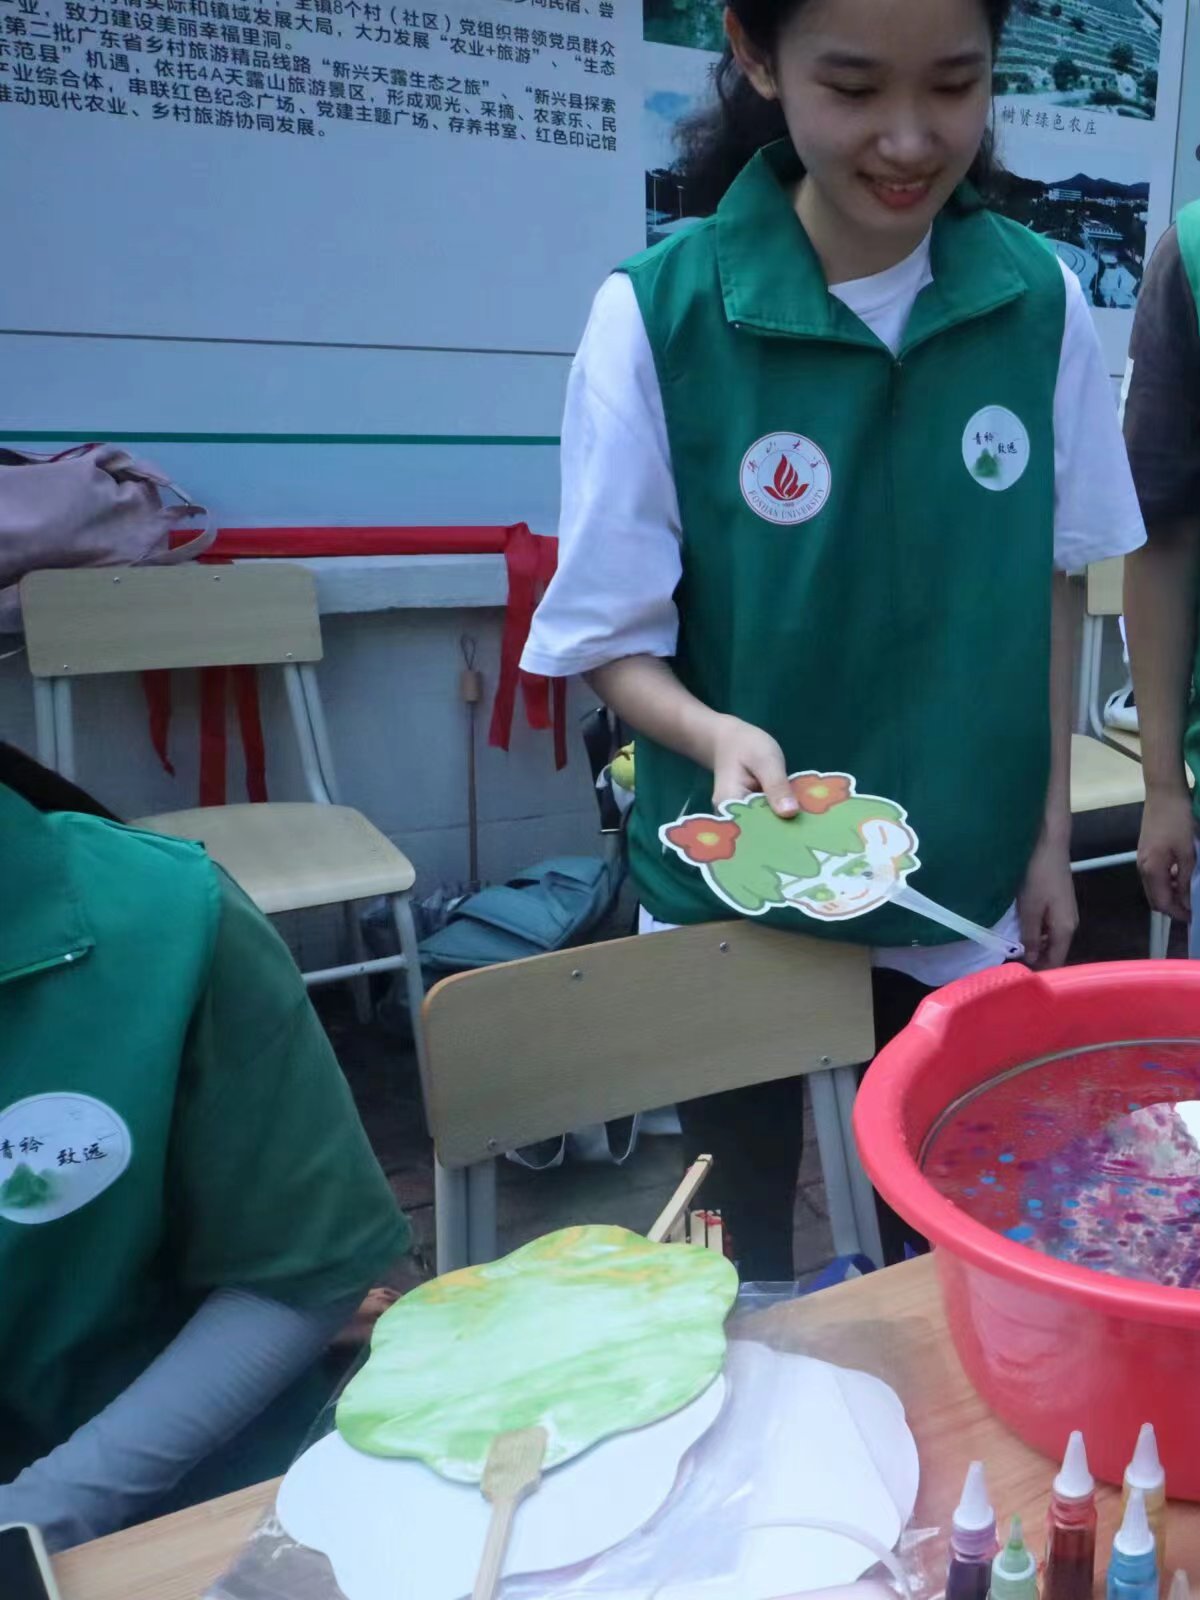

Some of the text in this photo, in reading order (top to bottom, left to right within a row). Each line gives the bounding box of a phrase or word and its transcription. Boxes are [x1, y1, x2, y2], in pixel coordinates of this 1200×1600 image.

[0, 0, 294, 51] 业，致力建设美丽幸福里洞。
[240, 0, 615, 57] ，全镇8个村（社区）党组织带领党员群众
[0, 16, 616, 114] 第二批广东省乡村旅游精品线路“新兴天露生态之旅”、“新兴县探索
[1002, 105, 1097, 135] 树贤绿色农庄
[748, 489, 778, 517] FOSHAN
